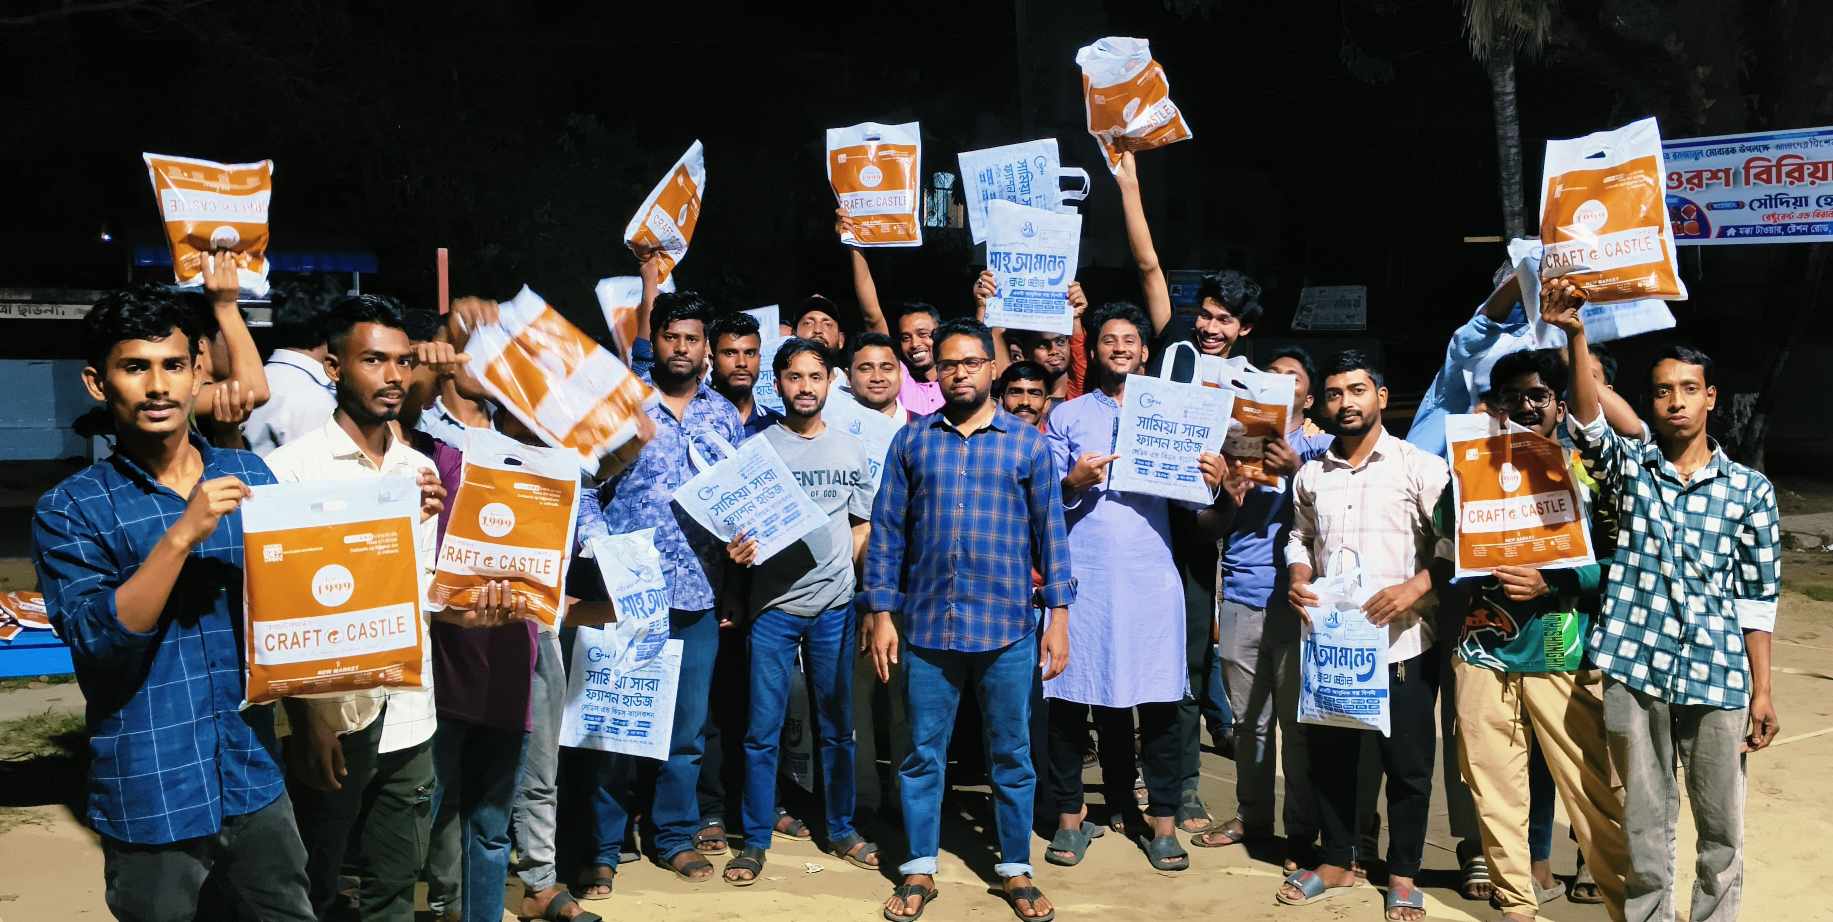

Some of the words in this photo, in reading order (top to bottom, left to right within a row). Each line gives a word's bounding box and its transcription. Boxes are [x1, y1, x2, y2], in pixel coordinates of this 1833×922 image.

[1749, 192, 1809, 211] সৌদিয়া
[1545, 248, 1584, 269] CRAFT
[1604, 236, 1654, 257] CASTLE
[1136, 413, 1178, 435] সামিয়া
[1182, 423, 1210, 439] সারা
[1136, 433, 1170, 450] ফ্যাশন
[1173, 438, 1203, 454] হাউজ
[709, 486, 751, 517] সামিয়া
[748, 468, 779, 491] সারা
[823, 490, 837, 498] GOD
[1468, 508, 1505, 524] CRAFT
[1521, 498, 1567, 518] CASTLE
[499, 554, 552, 575] CASTLE
[264, 629, 322, 652] CRAFT
[346, 615, 406, 641] CASTLE
[630, 677, 660, 692] সারা
[586, 688, 619, 705] ফ্যাশন
[622, 692, 654, 708] হাউজ
